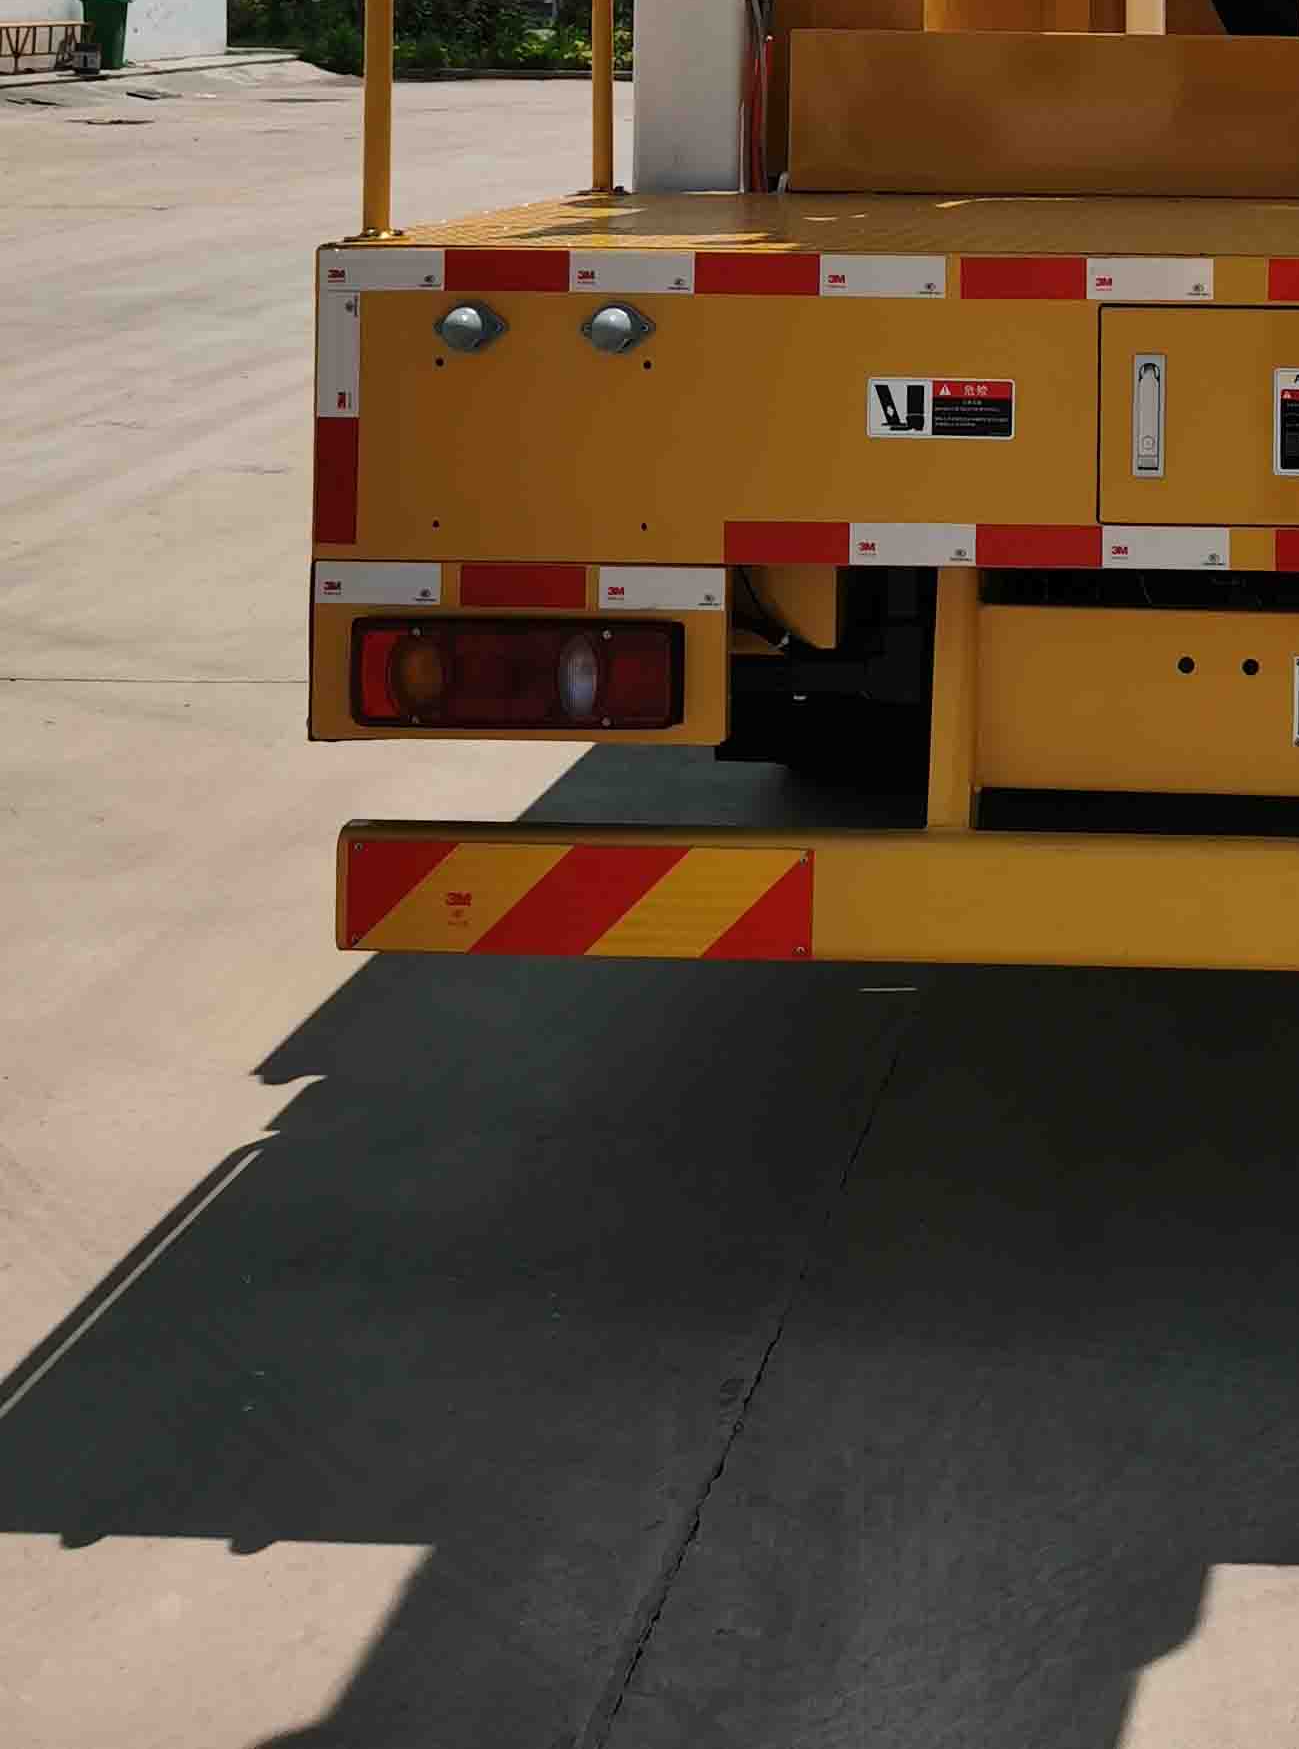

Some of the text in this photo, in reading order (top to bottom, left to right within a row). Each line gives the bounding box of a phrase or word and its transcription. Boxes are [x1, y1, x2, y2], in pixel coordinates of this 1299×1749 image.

[328, 269, 345, 280] 3M
[577, 270, 594, 280] 3M
[828, 274, 845, 283] 3M
[1096, 277, 1112, 286] 3M
[858, 542, 875, 551] 3M
[1111, 546, 1128, 555] 3M
[323, 581, 341, 591] 3M
[608, 586, 624, 595] 3M
[445, 893, 472, 906] 3M
